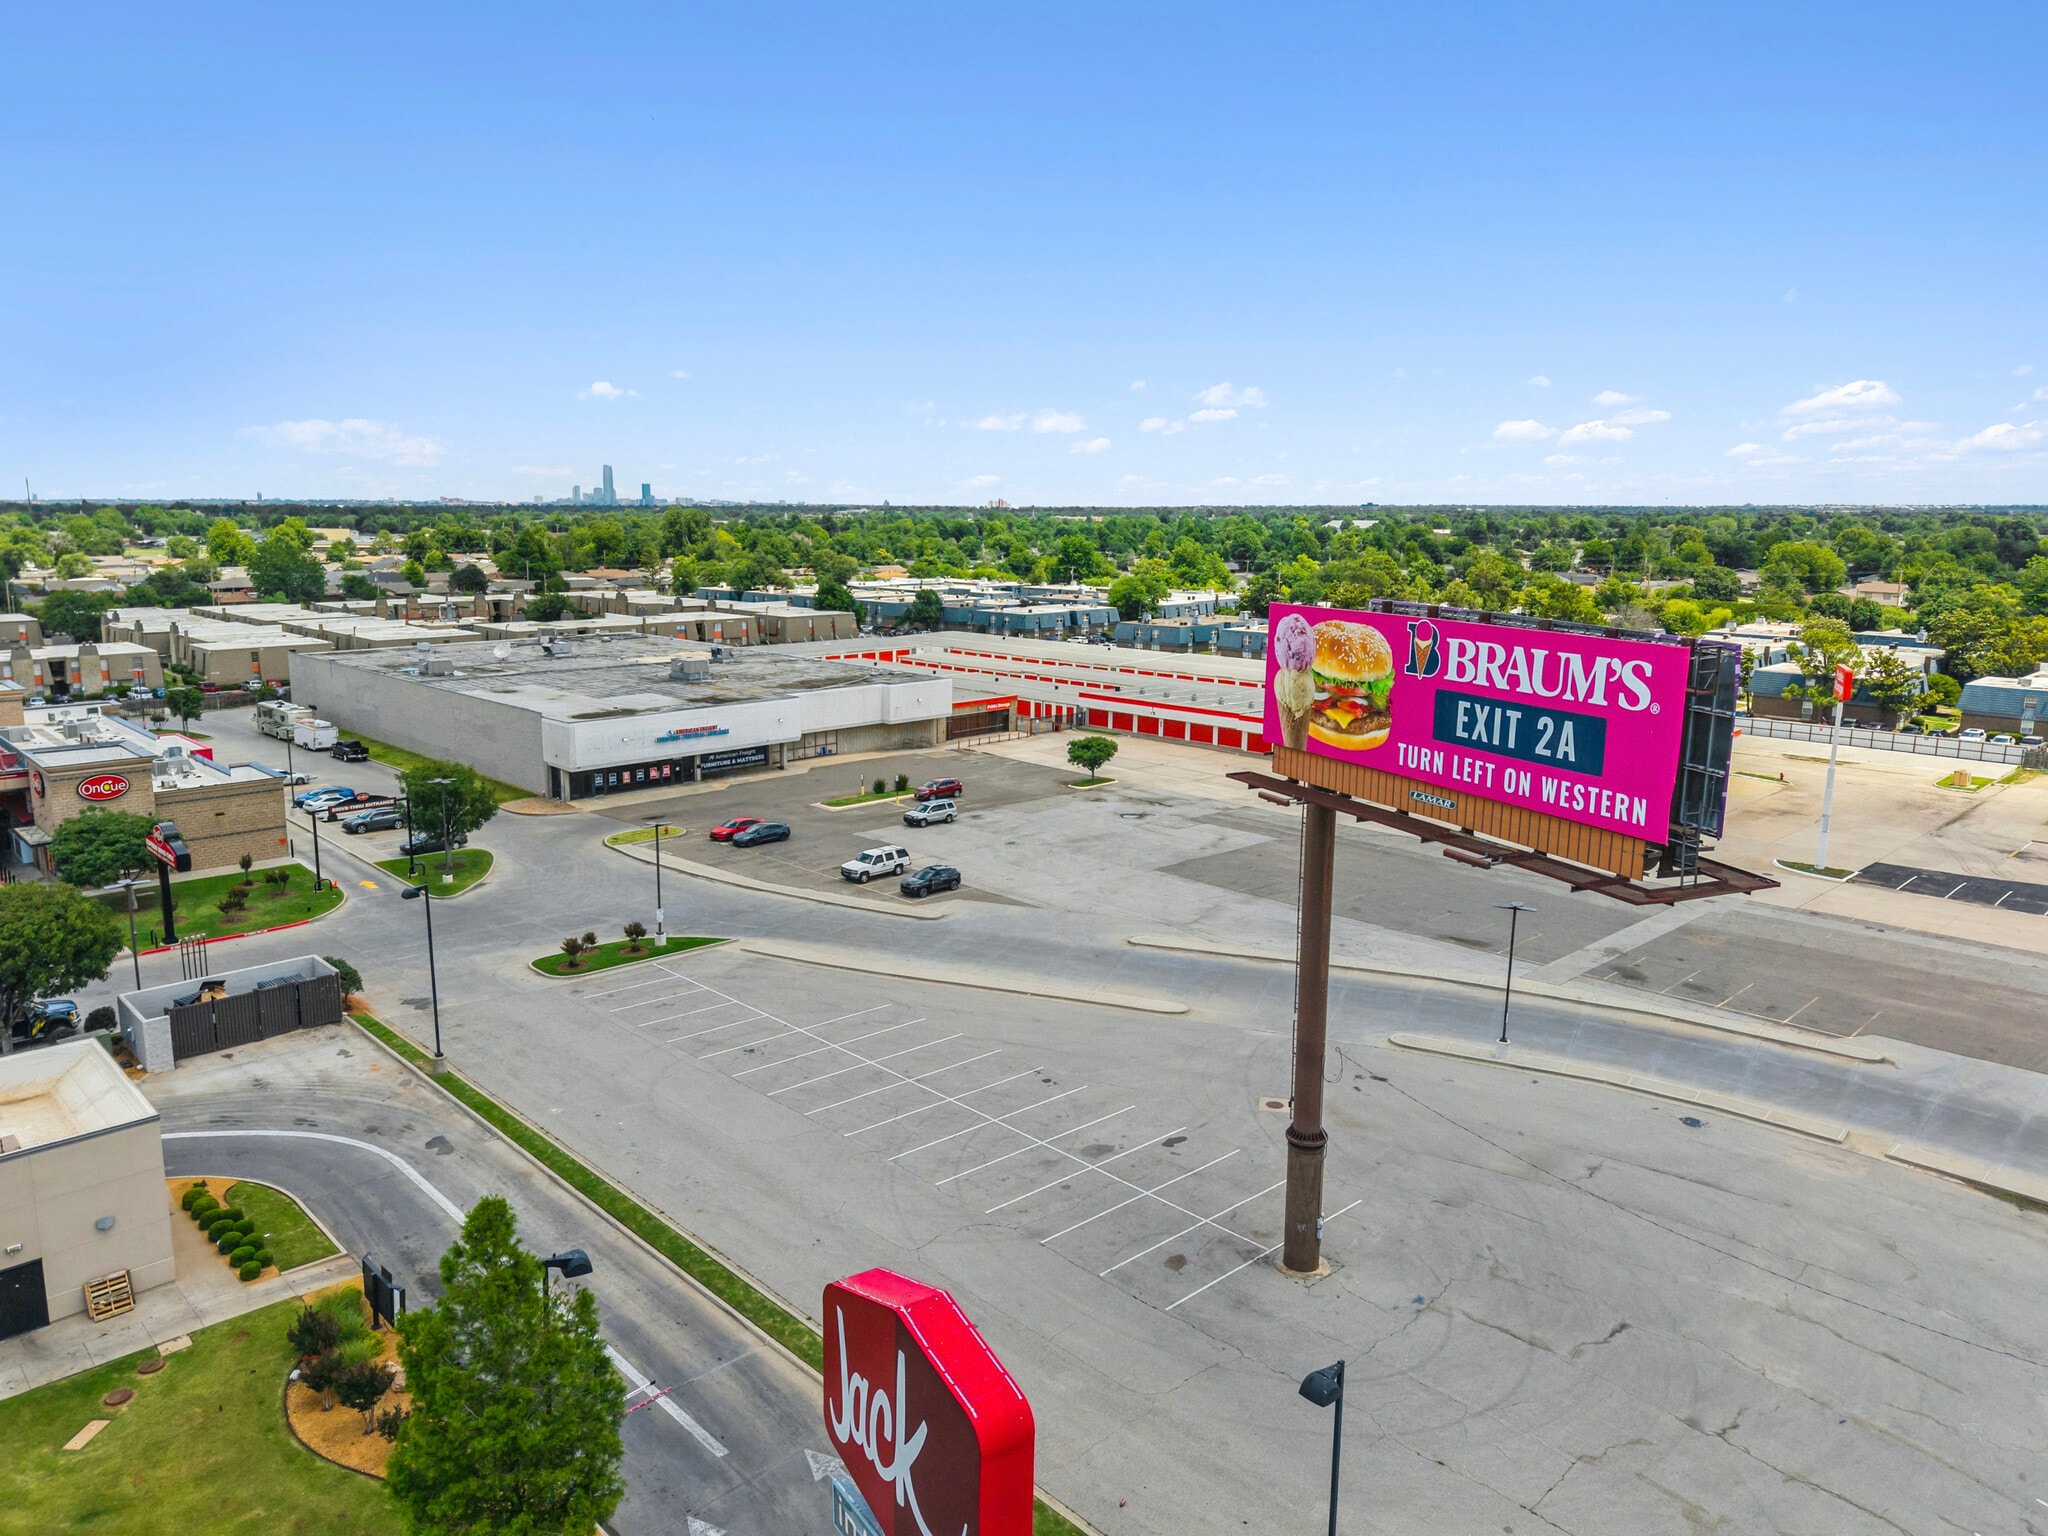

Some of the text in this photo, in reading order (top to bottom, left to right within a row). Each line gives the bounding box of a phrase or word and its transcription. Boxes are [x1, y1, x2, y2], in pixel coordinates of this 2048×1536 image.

[1443, 637, 1653, 711] BRAUM'S
[1455, 700, 1576, 762] EXIT 2A
[737, 753, 765, 763] MATTRESS
[739, 749, 756, 757] Freight
[81, 780, 126, 795] OnCue
[1397, 742, 1647, 827] TURN LEFT ON WESTERN
[1411, 791, 1452, 809] LAMAR
[829, 1304, 932, 1524] Jack
